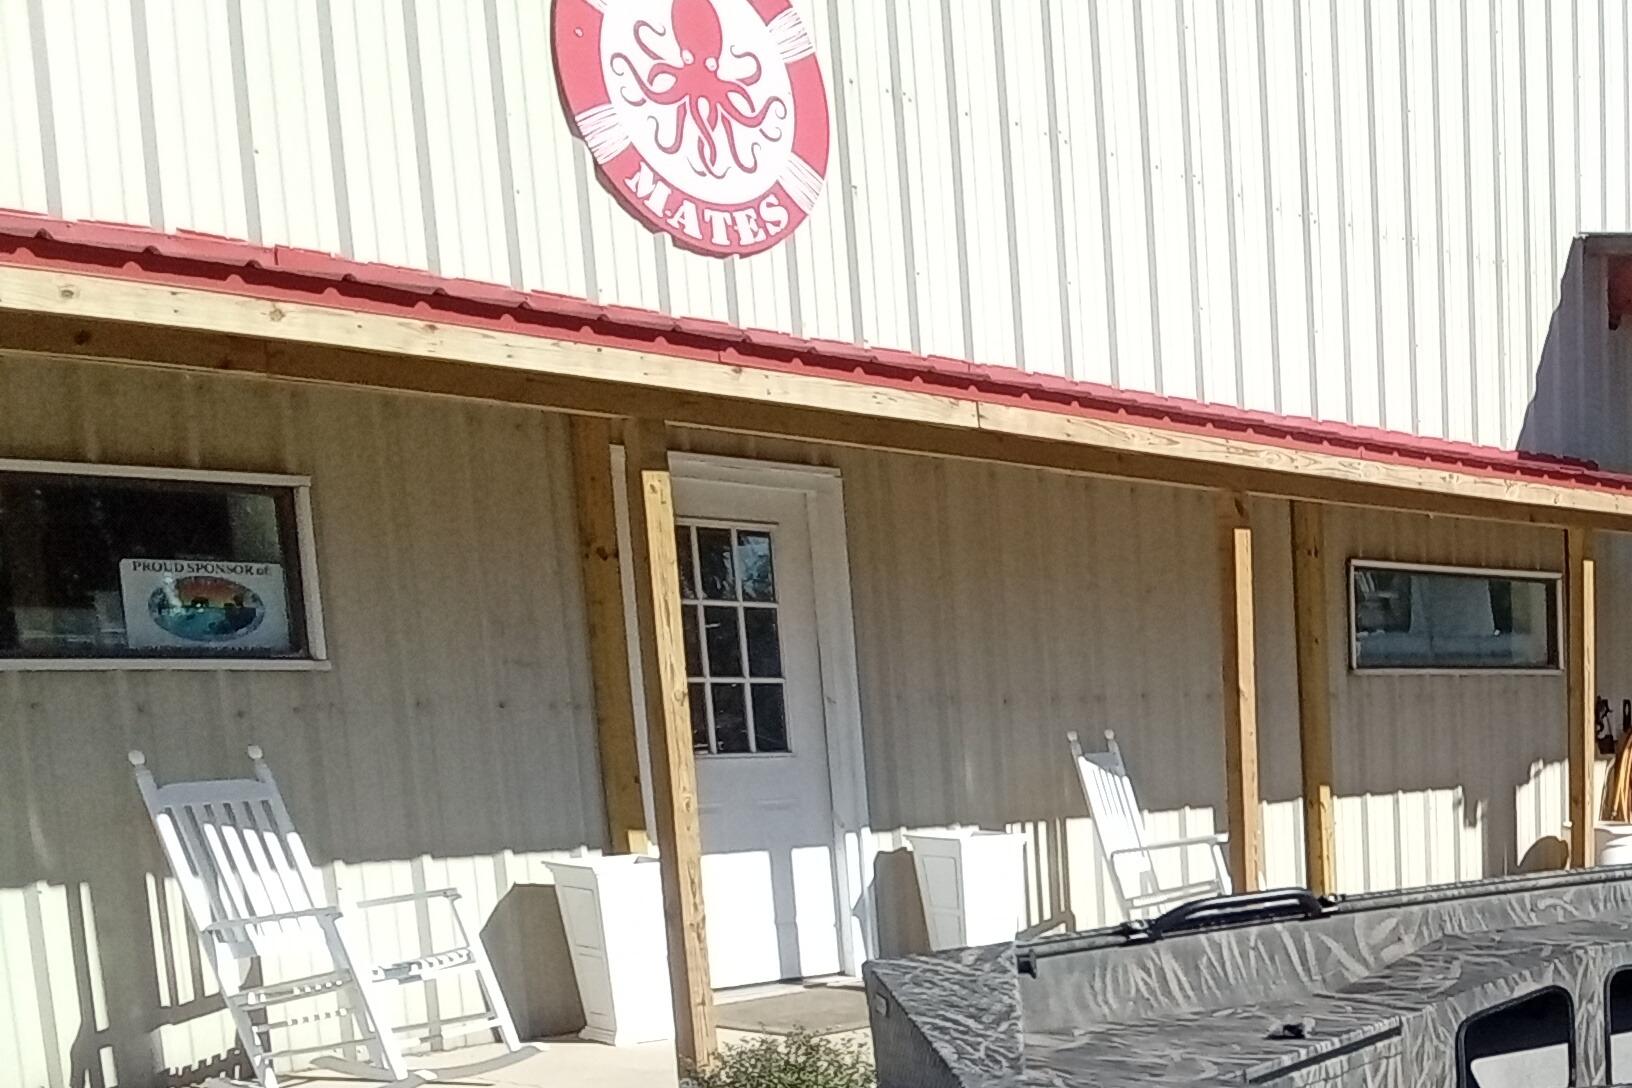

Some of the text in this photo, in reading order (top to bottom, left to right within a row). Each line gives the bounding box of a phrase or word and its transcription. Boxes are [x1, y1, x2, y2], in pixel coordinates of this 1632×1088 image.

[623, 161, 790, 248] MATES
[132, 561, 184, 573] PROUD
[187, 563, 254, 575] SPONSOR
